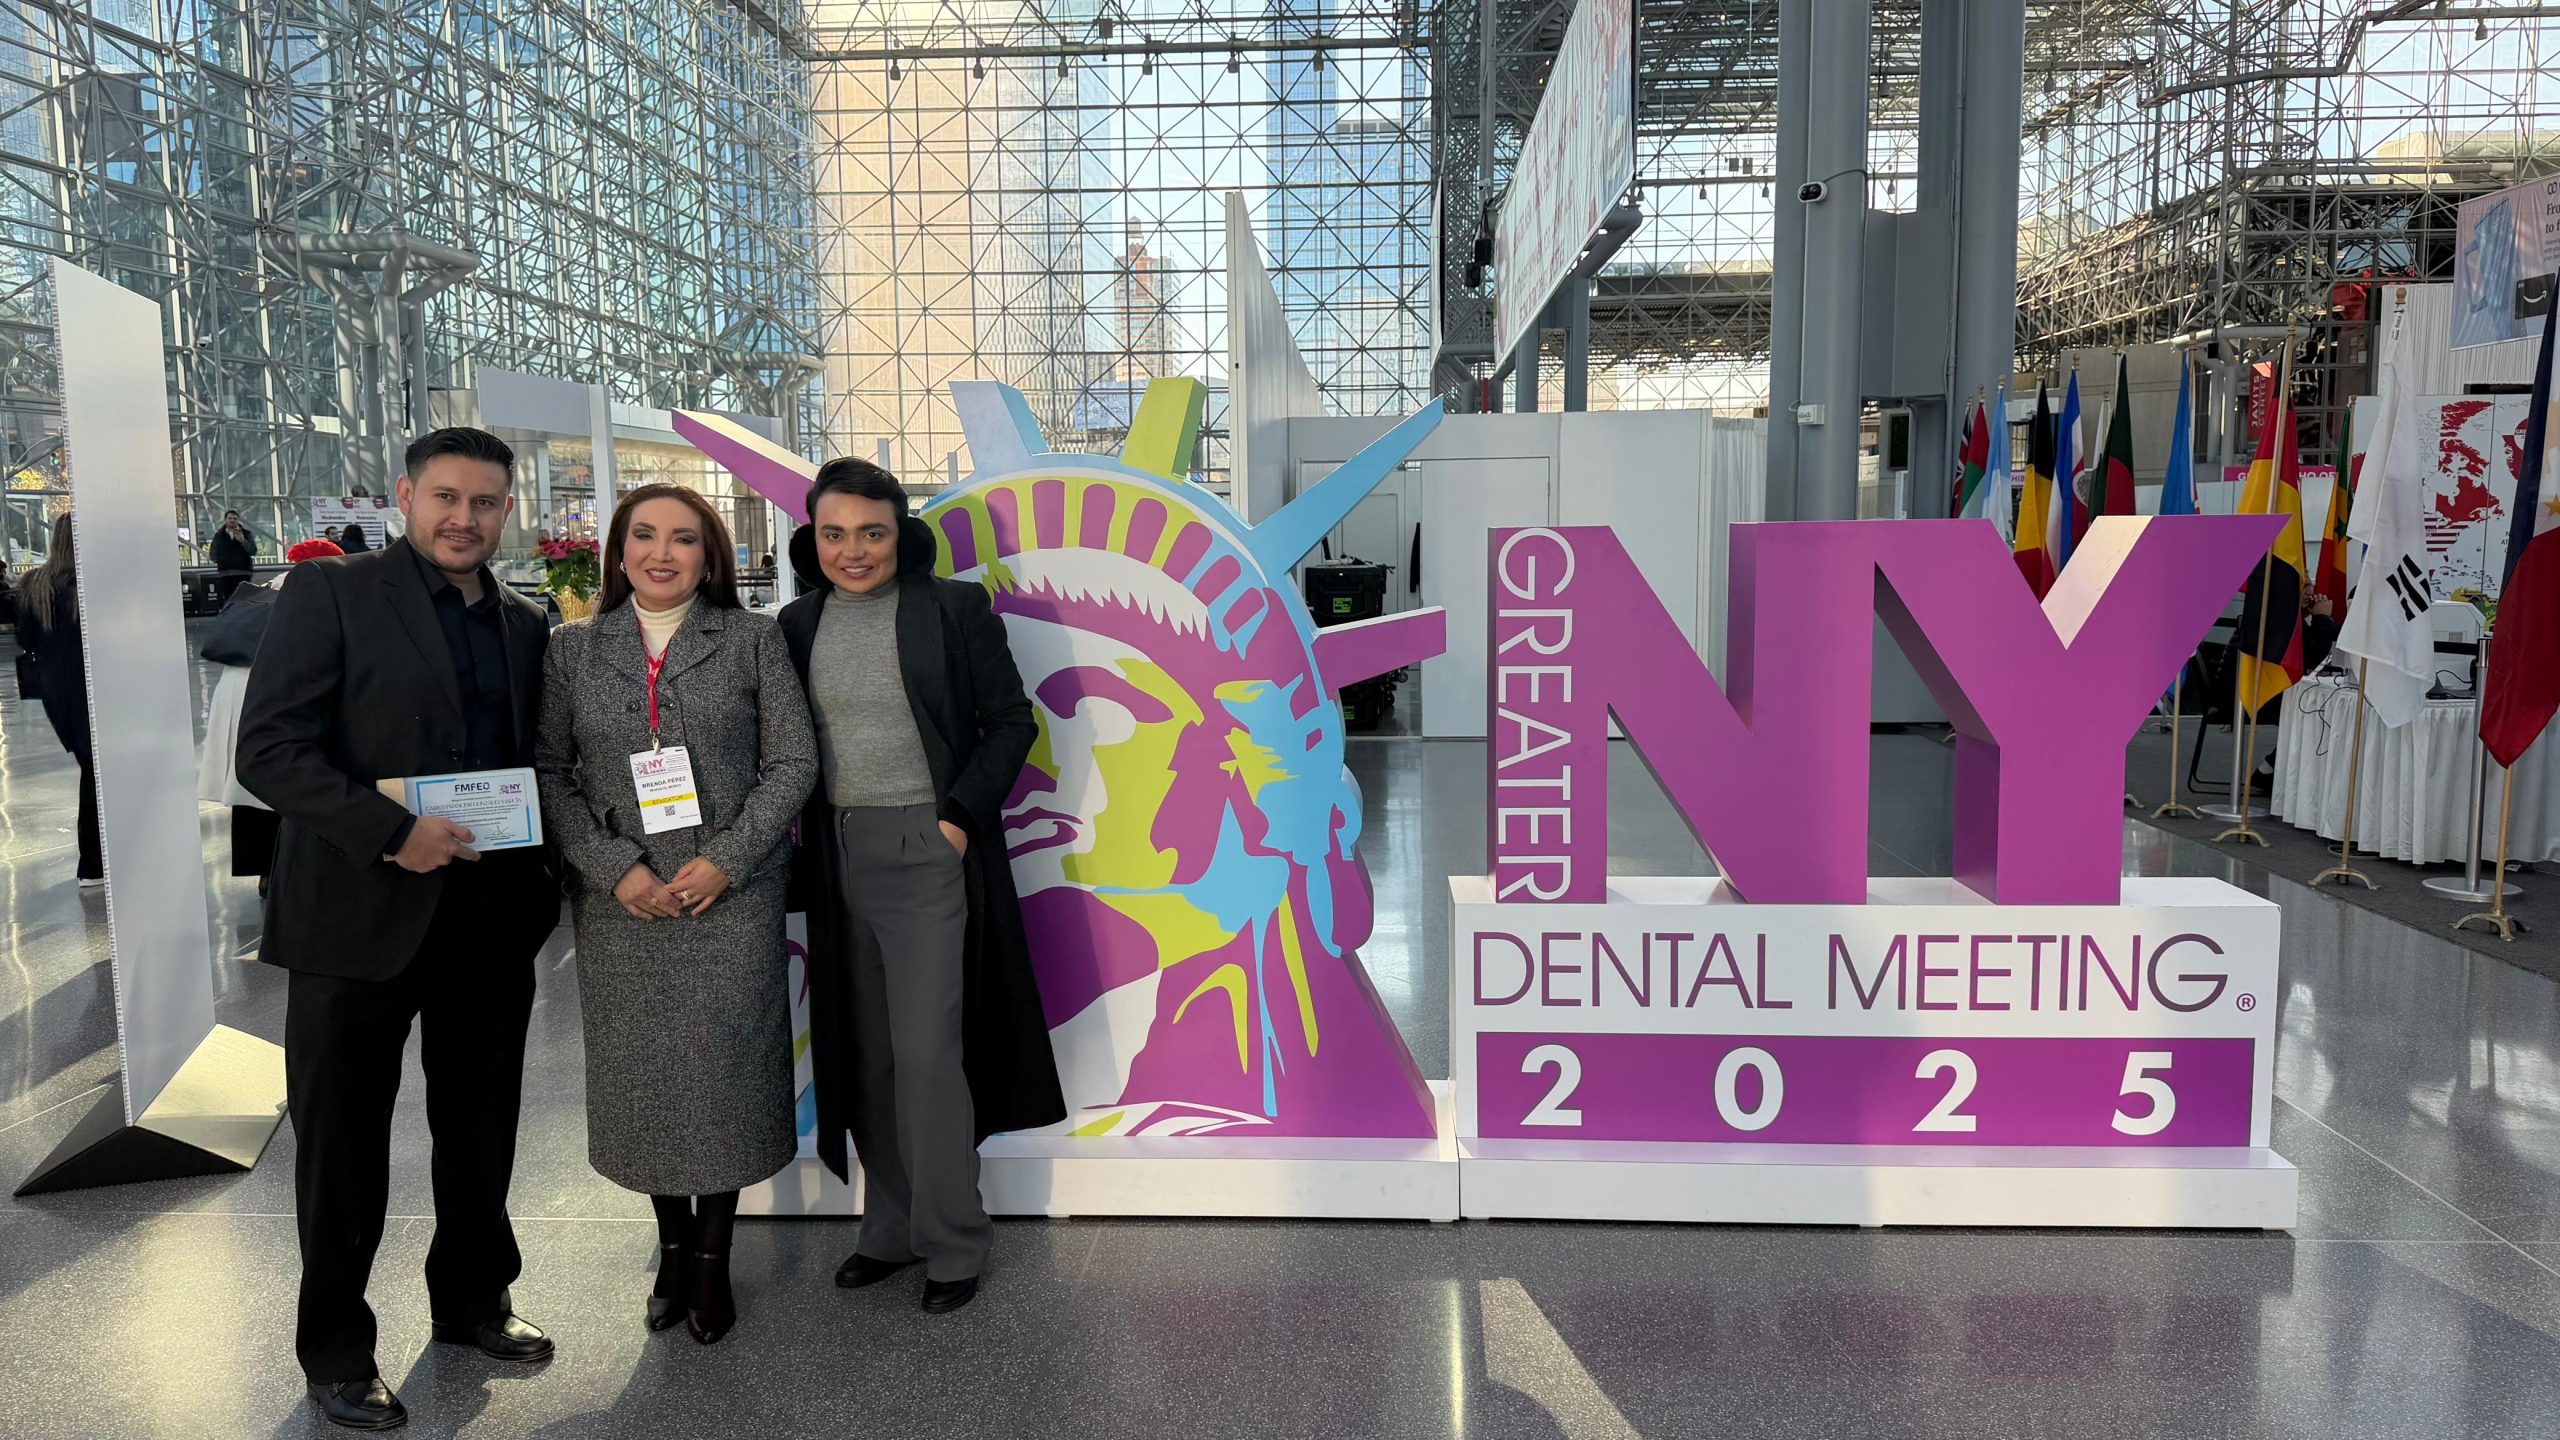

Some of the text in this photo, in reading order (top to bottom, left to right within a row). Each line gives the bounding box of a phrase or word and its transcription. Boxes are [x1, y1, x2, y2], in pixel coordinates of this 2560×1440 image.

[2251, 375, 2260, 427] JAVITS
[1488, 513, 2290, 905] NY
[1498, 526, 1575, 901] GREATER
[648, 758, 664, 769] NY
[454, 781, 490, 793] FMFEO
[642, 776, 687, 789] BRENDA PEREZ
[652, 795, 683, 805] EDUCATOR
[1473, 931, 1794, 1010] DENTAL
